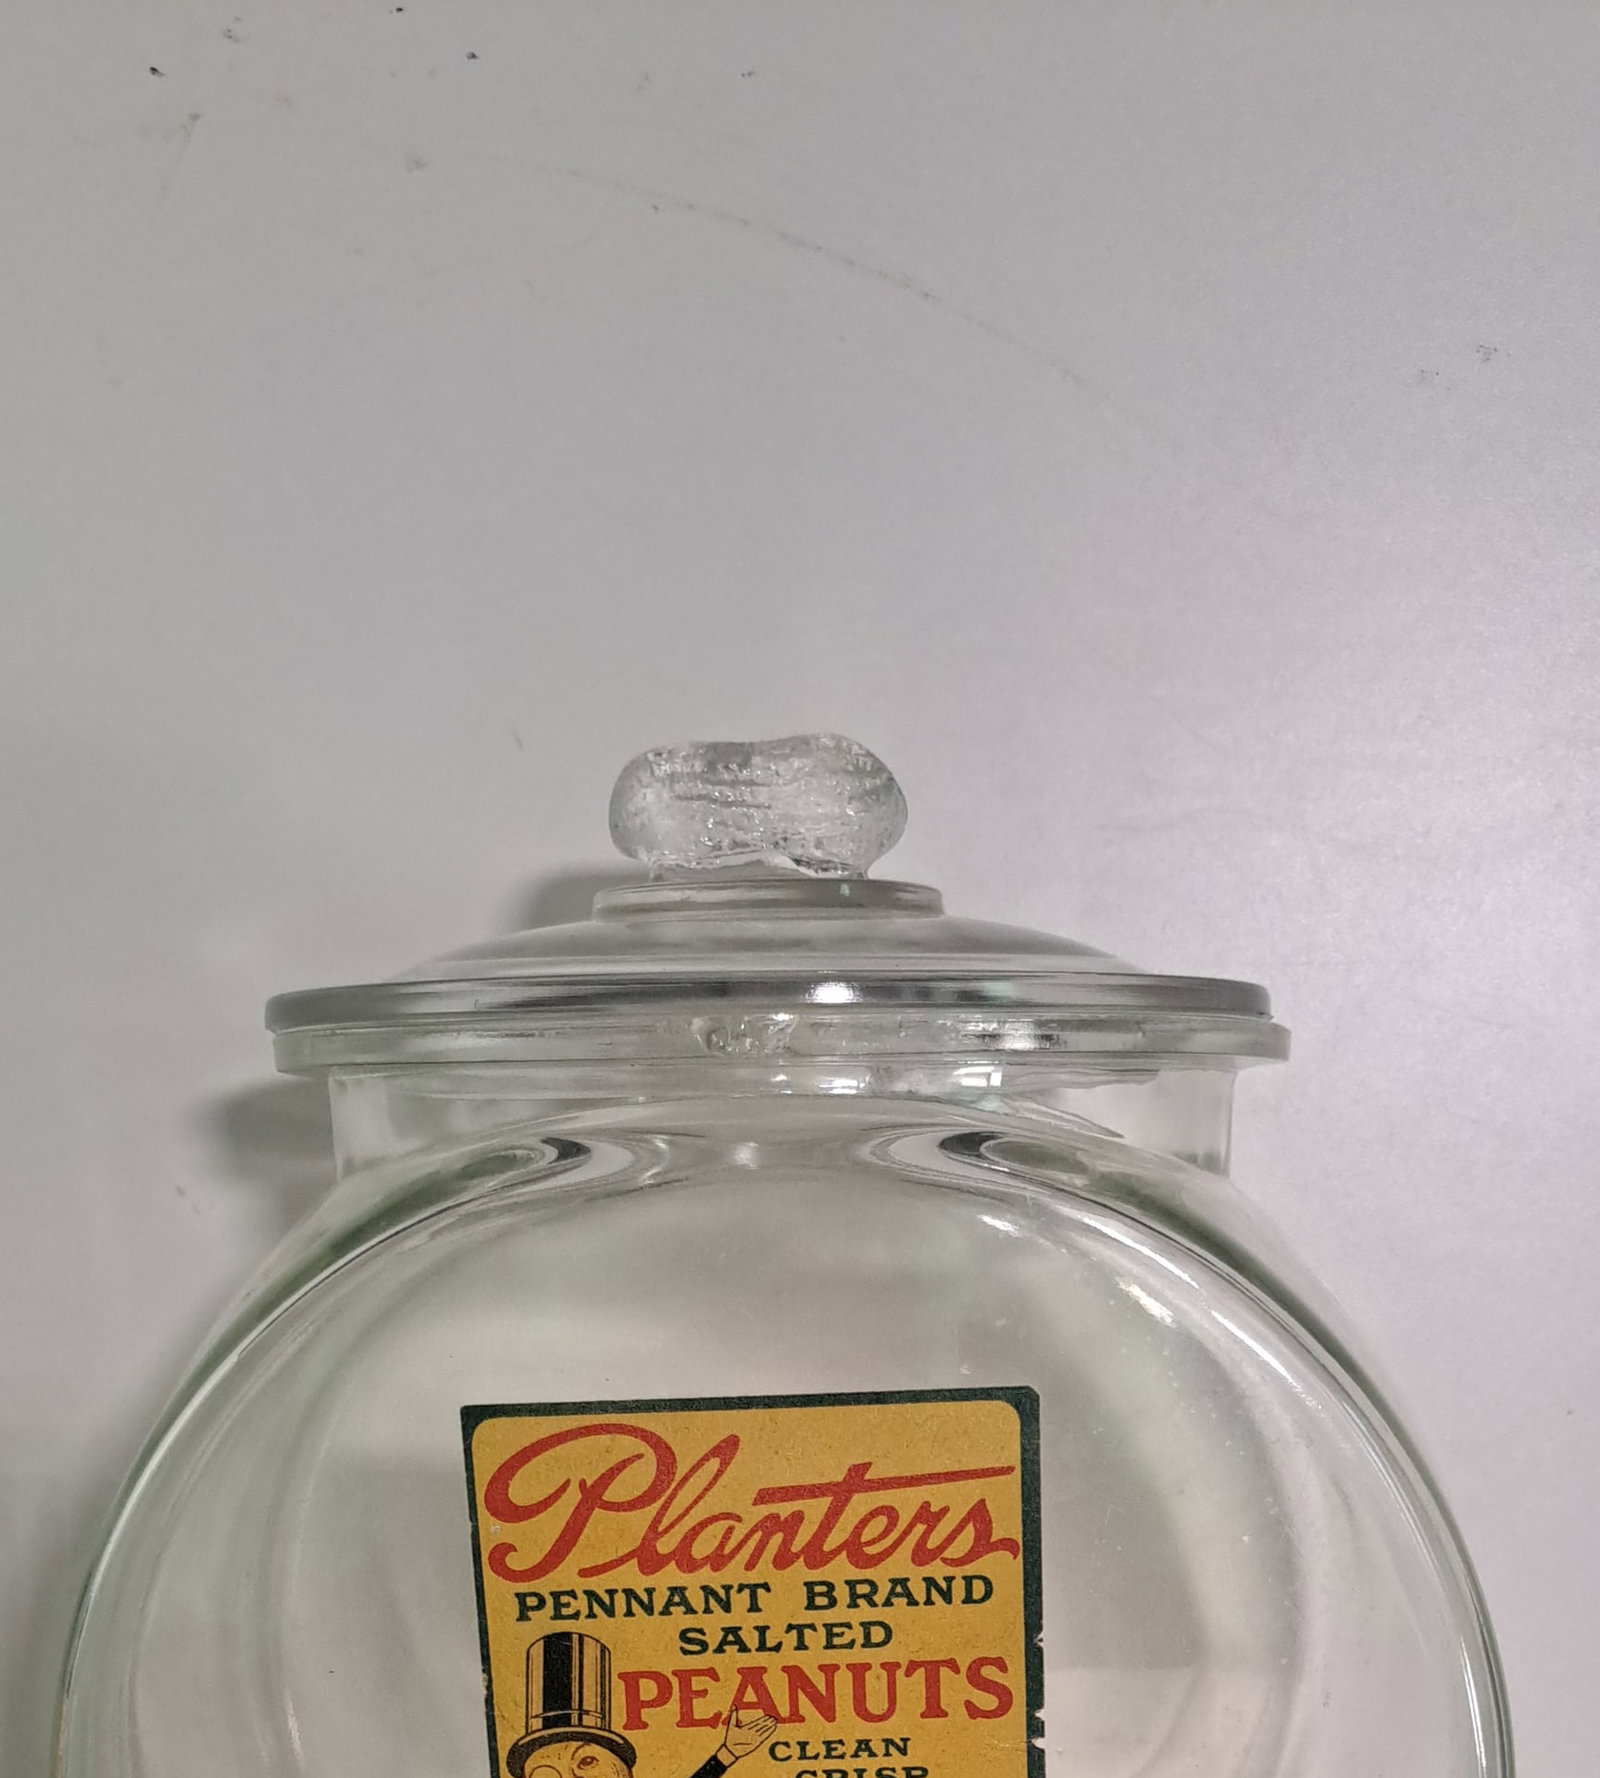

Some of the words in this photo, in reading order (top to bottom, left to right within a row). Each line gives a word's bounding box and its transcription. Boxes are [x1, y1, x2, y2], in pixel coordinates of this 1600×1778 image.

[483, 1422, 1021, 1583] Planters
[515, 1581, 771, 1622] PENNANT
[804, 1574, 994, 1612] BRAND
[679, 1620, 894, 1656] SALTED
[617, 1656, 1014, 1731] PEANUTS
[768, 1737, 911, 1763] CLEAN
